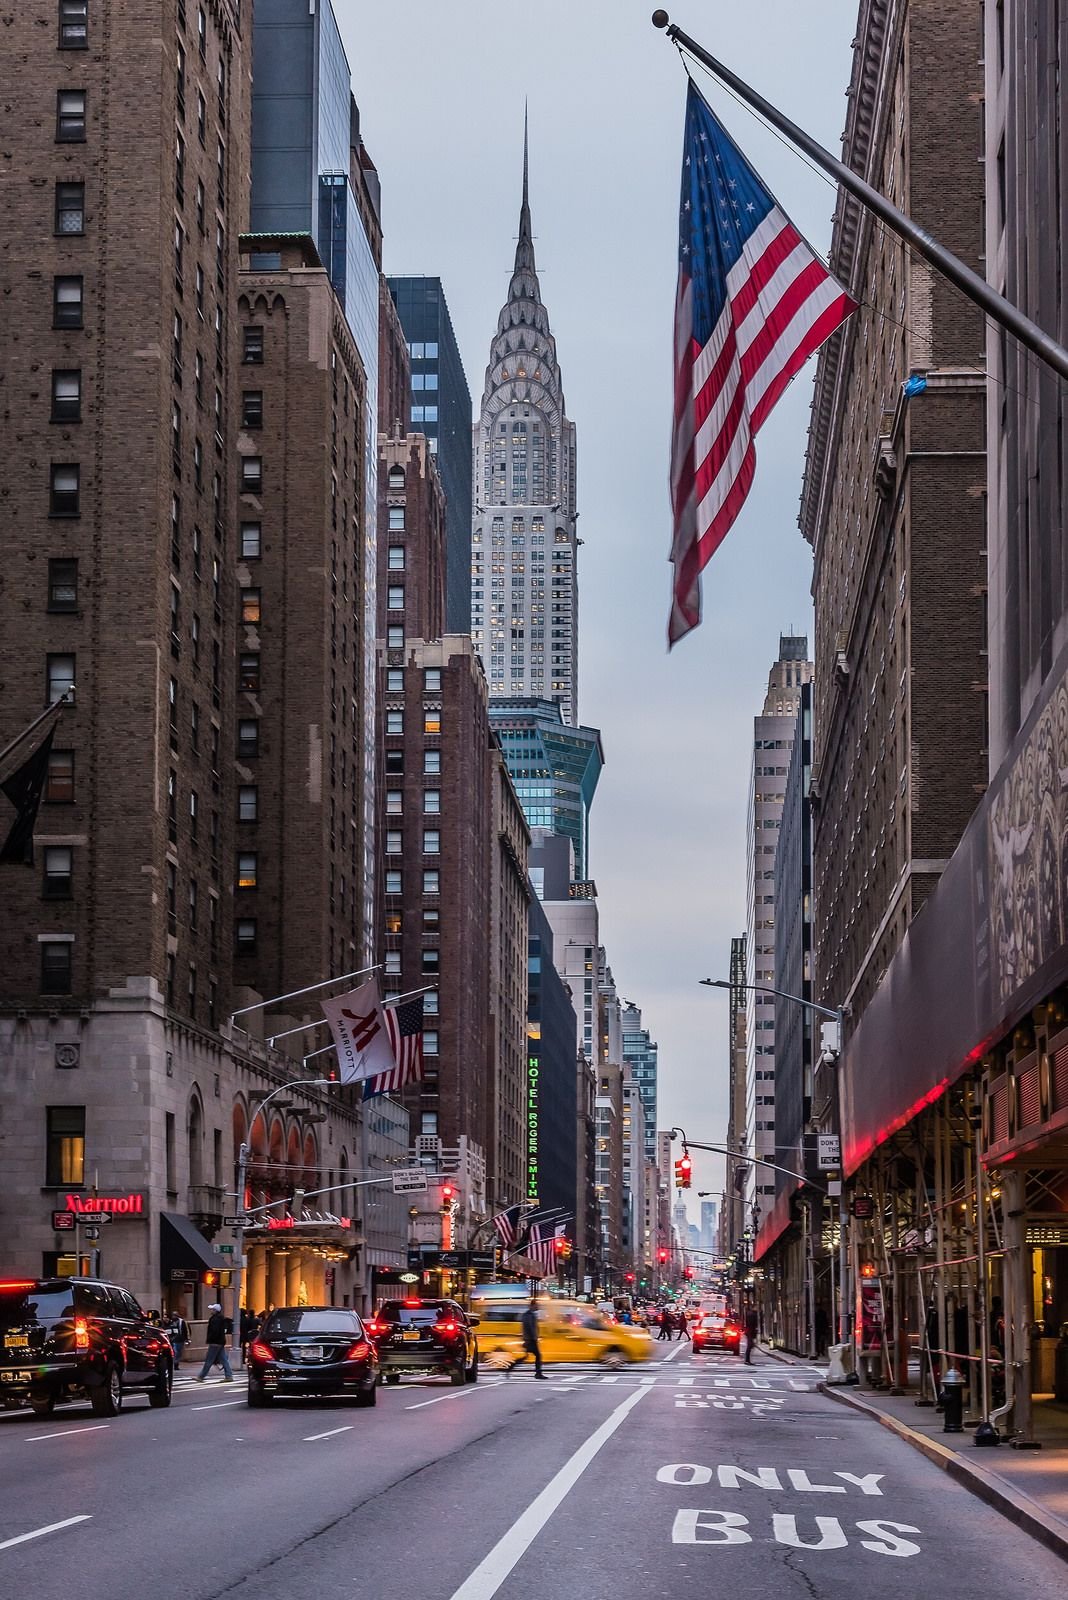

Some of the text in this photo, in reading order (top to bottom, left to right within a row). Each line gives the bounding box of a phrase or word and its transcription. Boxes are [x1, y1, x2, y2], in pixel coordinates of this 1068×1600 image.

[336, 1020, 355, 1069] MARRIOTT
[528, 1058, 539, 1196] HOTEL ROGER SMITH
[65, 1193, 144, 1214] Marriott
[673, 1393, 790, 1404] ONLY
[656, 1463, 887, 1496] ONLY
[671, 1508, 922, 1557] BUS
